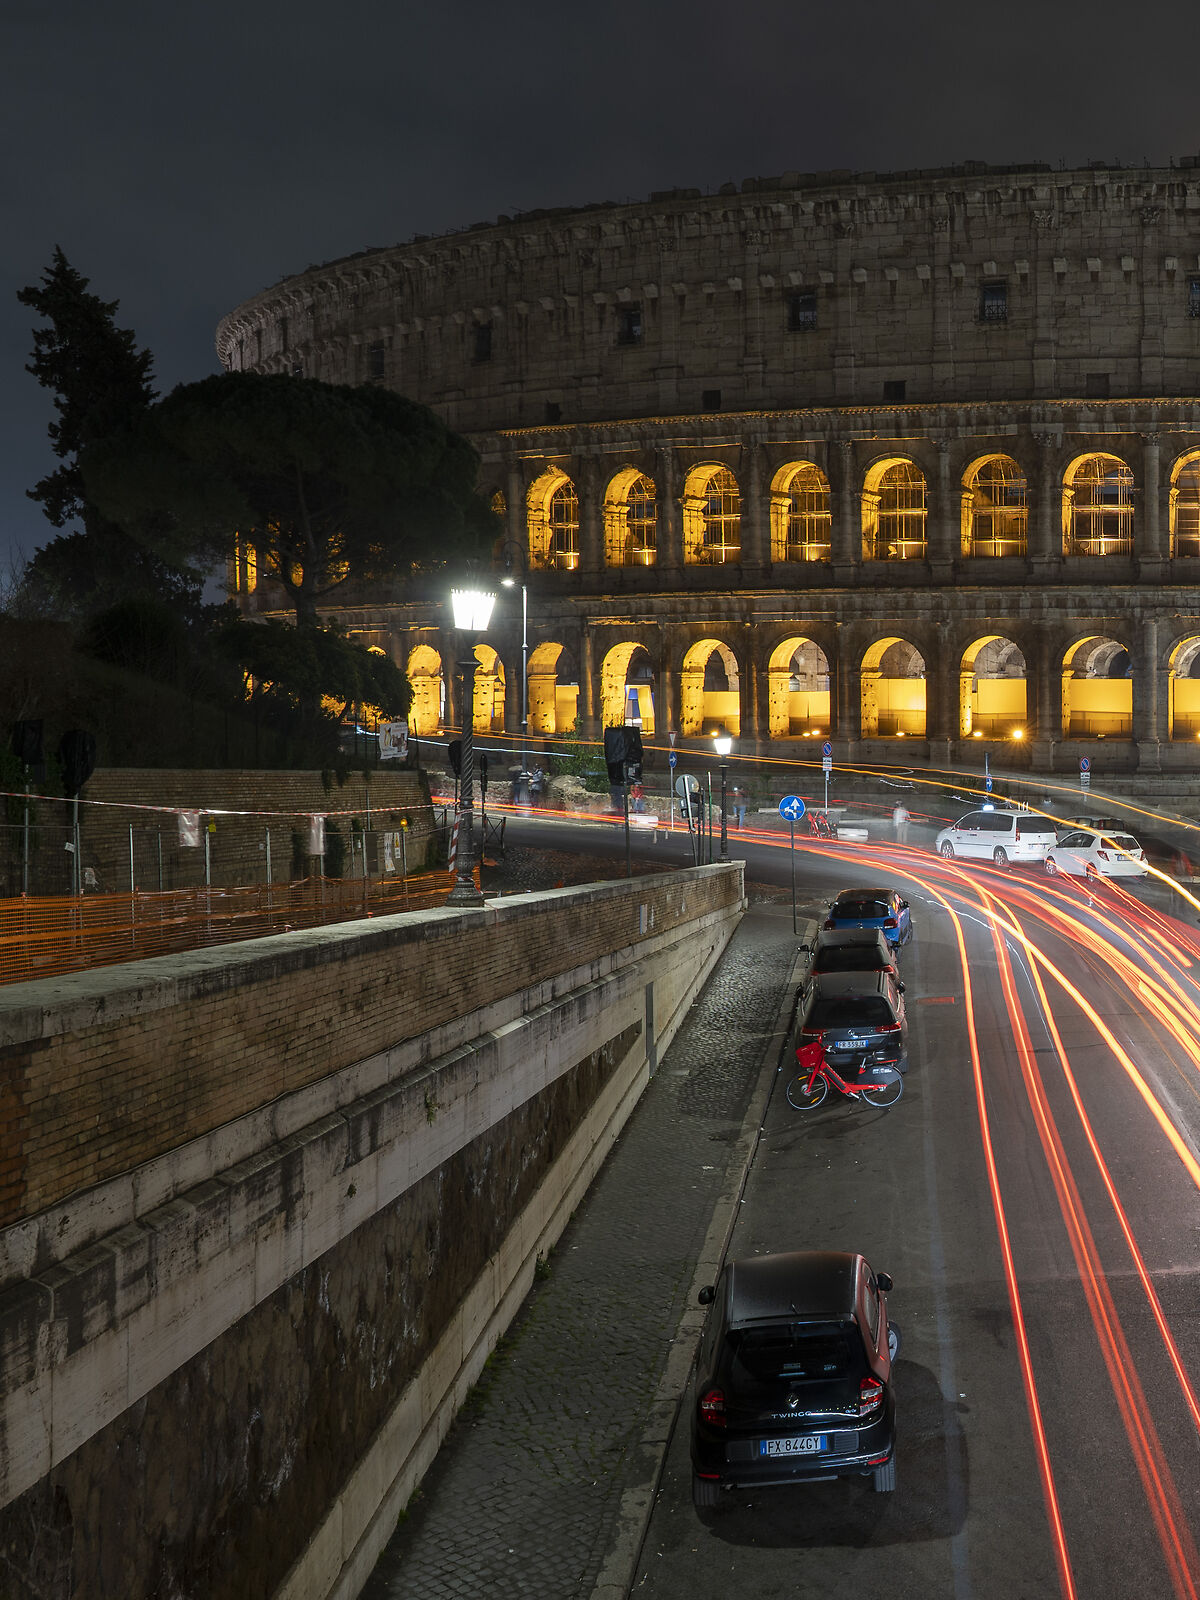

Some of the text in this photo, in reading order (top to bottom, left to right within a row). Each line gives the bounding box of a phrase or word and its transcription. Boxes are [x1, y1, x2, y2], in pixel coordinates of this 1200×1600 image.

[770, 1410, 812, 1419] TWINGO
[767, 1437, 820, 1453] FX 844GY
